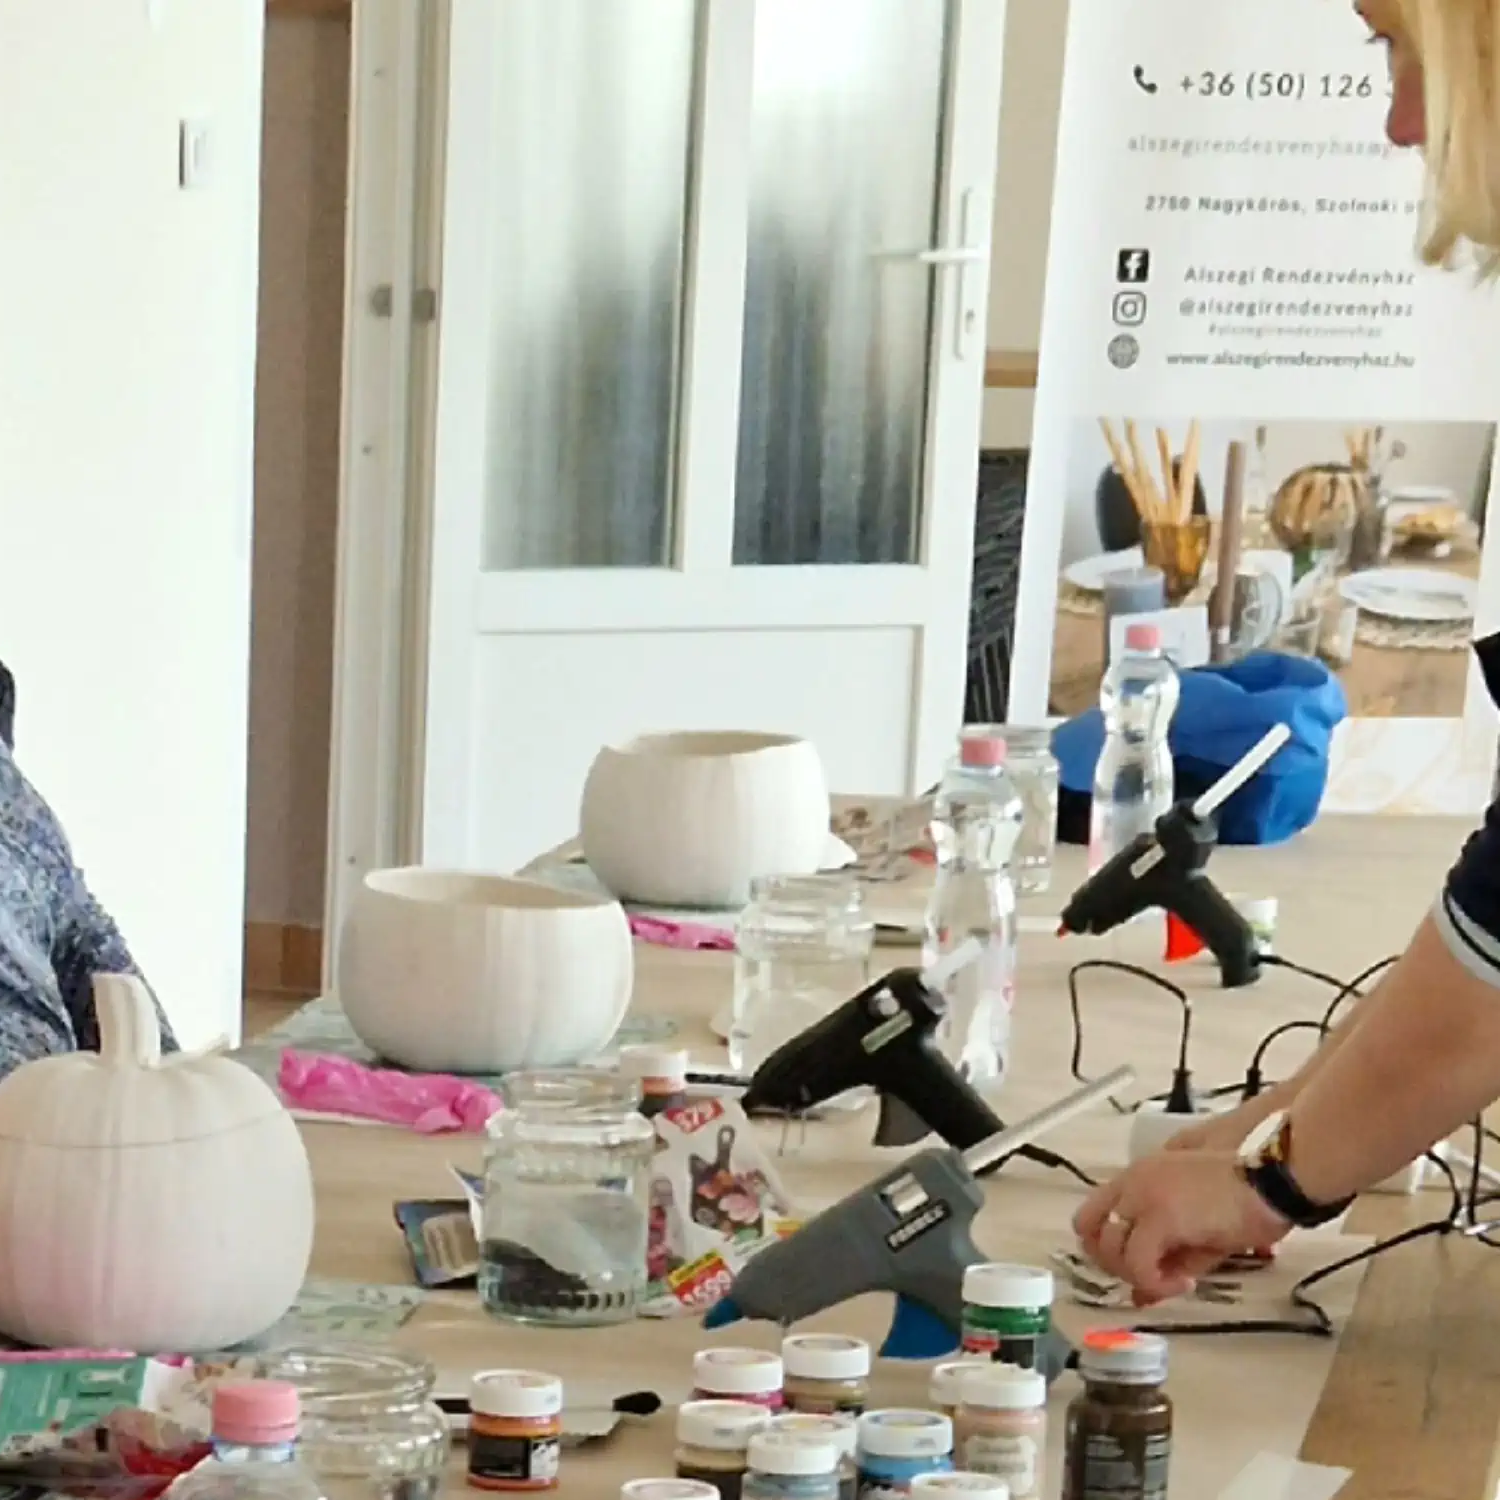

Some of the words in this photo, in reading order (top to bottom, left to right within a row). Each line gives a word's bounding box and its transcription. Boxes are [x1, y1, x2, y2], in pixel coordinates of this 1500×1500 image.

[1180, 71, 1235, 97] +36
[1246, 72, 1305, 101] (50)
[1321, 74, 1372, 98] 126
[1184, 266, 1254, 286] Alszegi
